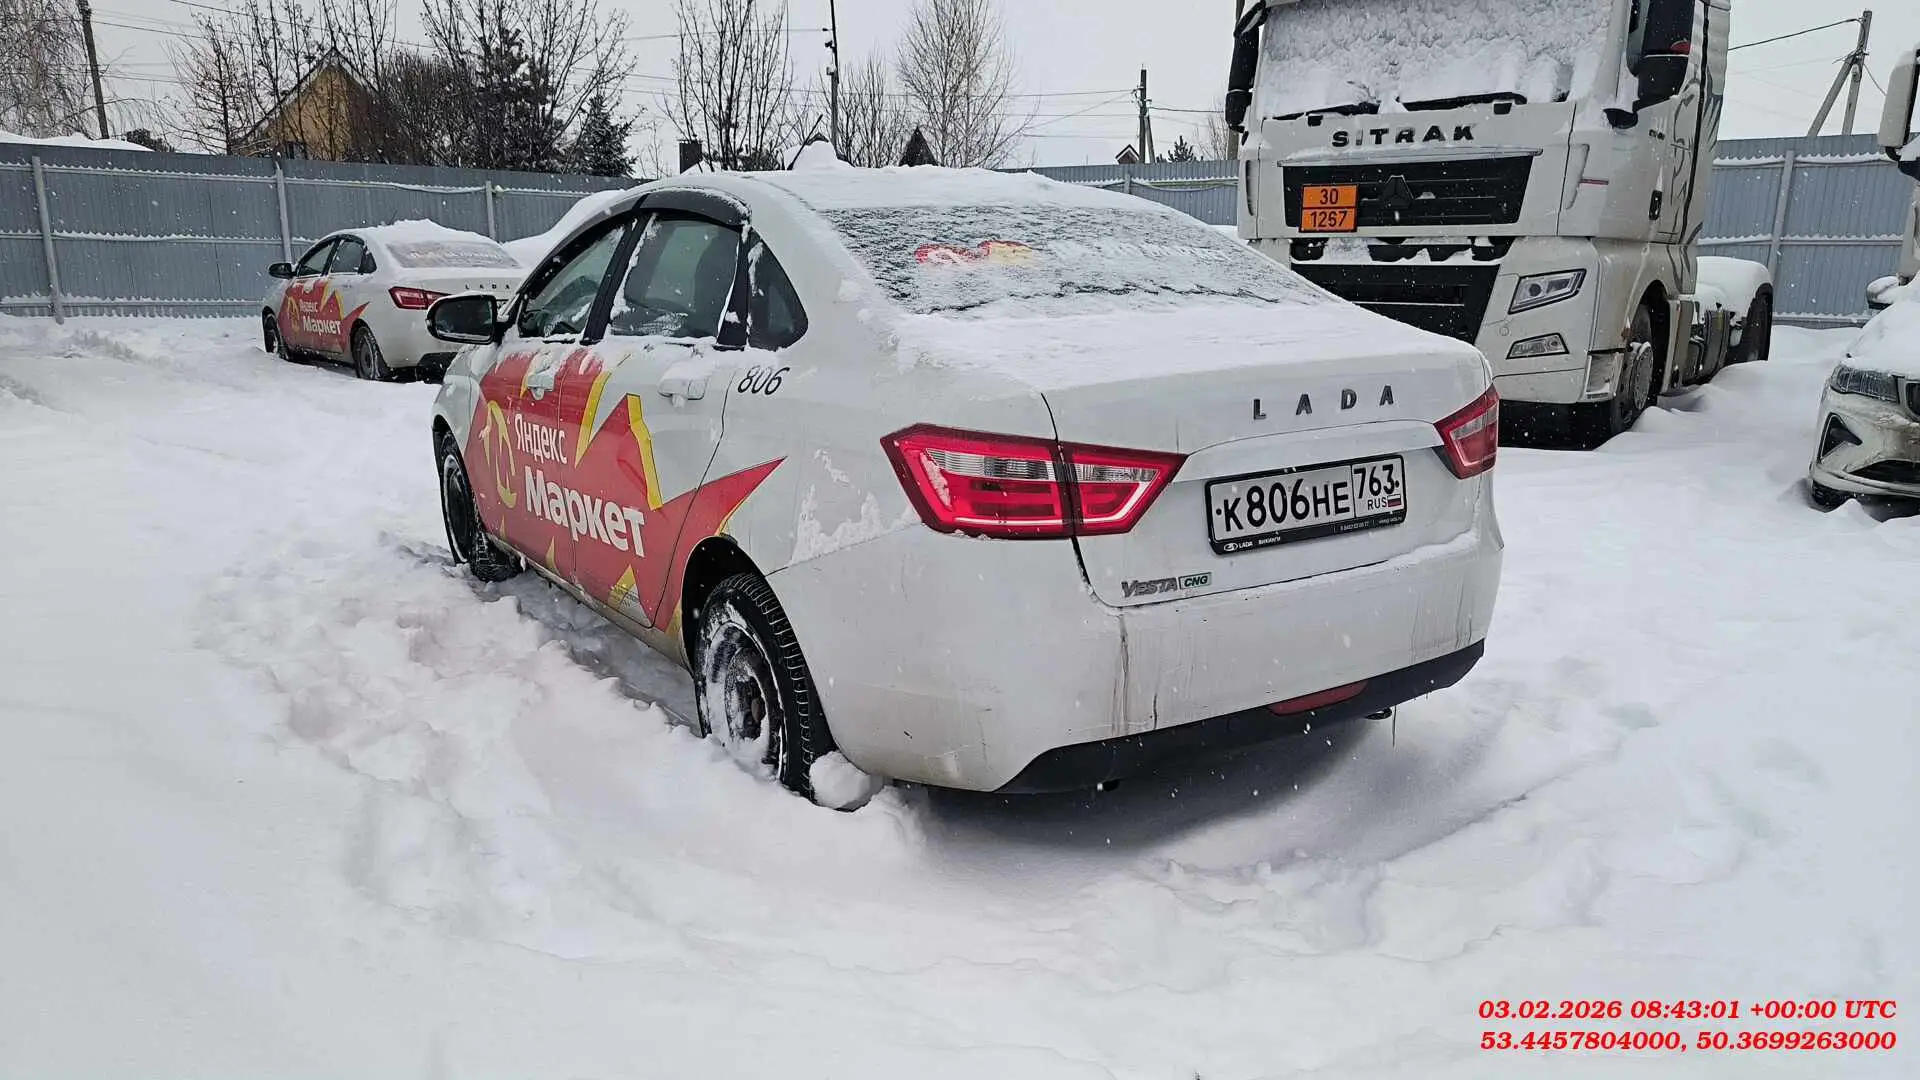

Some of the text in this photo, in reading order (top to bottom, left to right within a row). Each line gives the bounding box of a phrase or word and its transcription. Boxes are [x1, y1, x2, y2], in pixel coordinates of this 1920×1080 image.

[1332, 124, 1476, 148] SITRAK
[1319, 188, 1339, 205] 30
[1310, 211, 1348, 228] 1267
[465, 283, 510, 291] LADA
[302, 315, 341, 337] Маркет
[737, 366, 790, 396] 806
[1253, 384, 1395, 421] LADA
[514, 413, 568, 465] Яндекс
[1353, 463, 1395, 500] 763
[524, 465, 646, 559] Маркет
[1367, 497, 1388, 512] RUS
[1184, 575, 1209, 588] CNG
